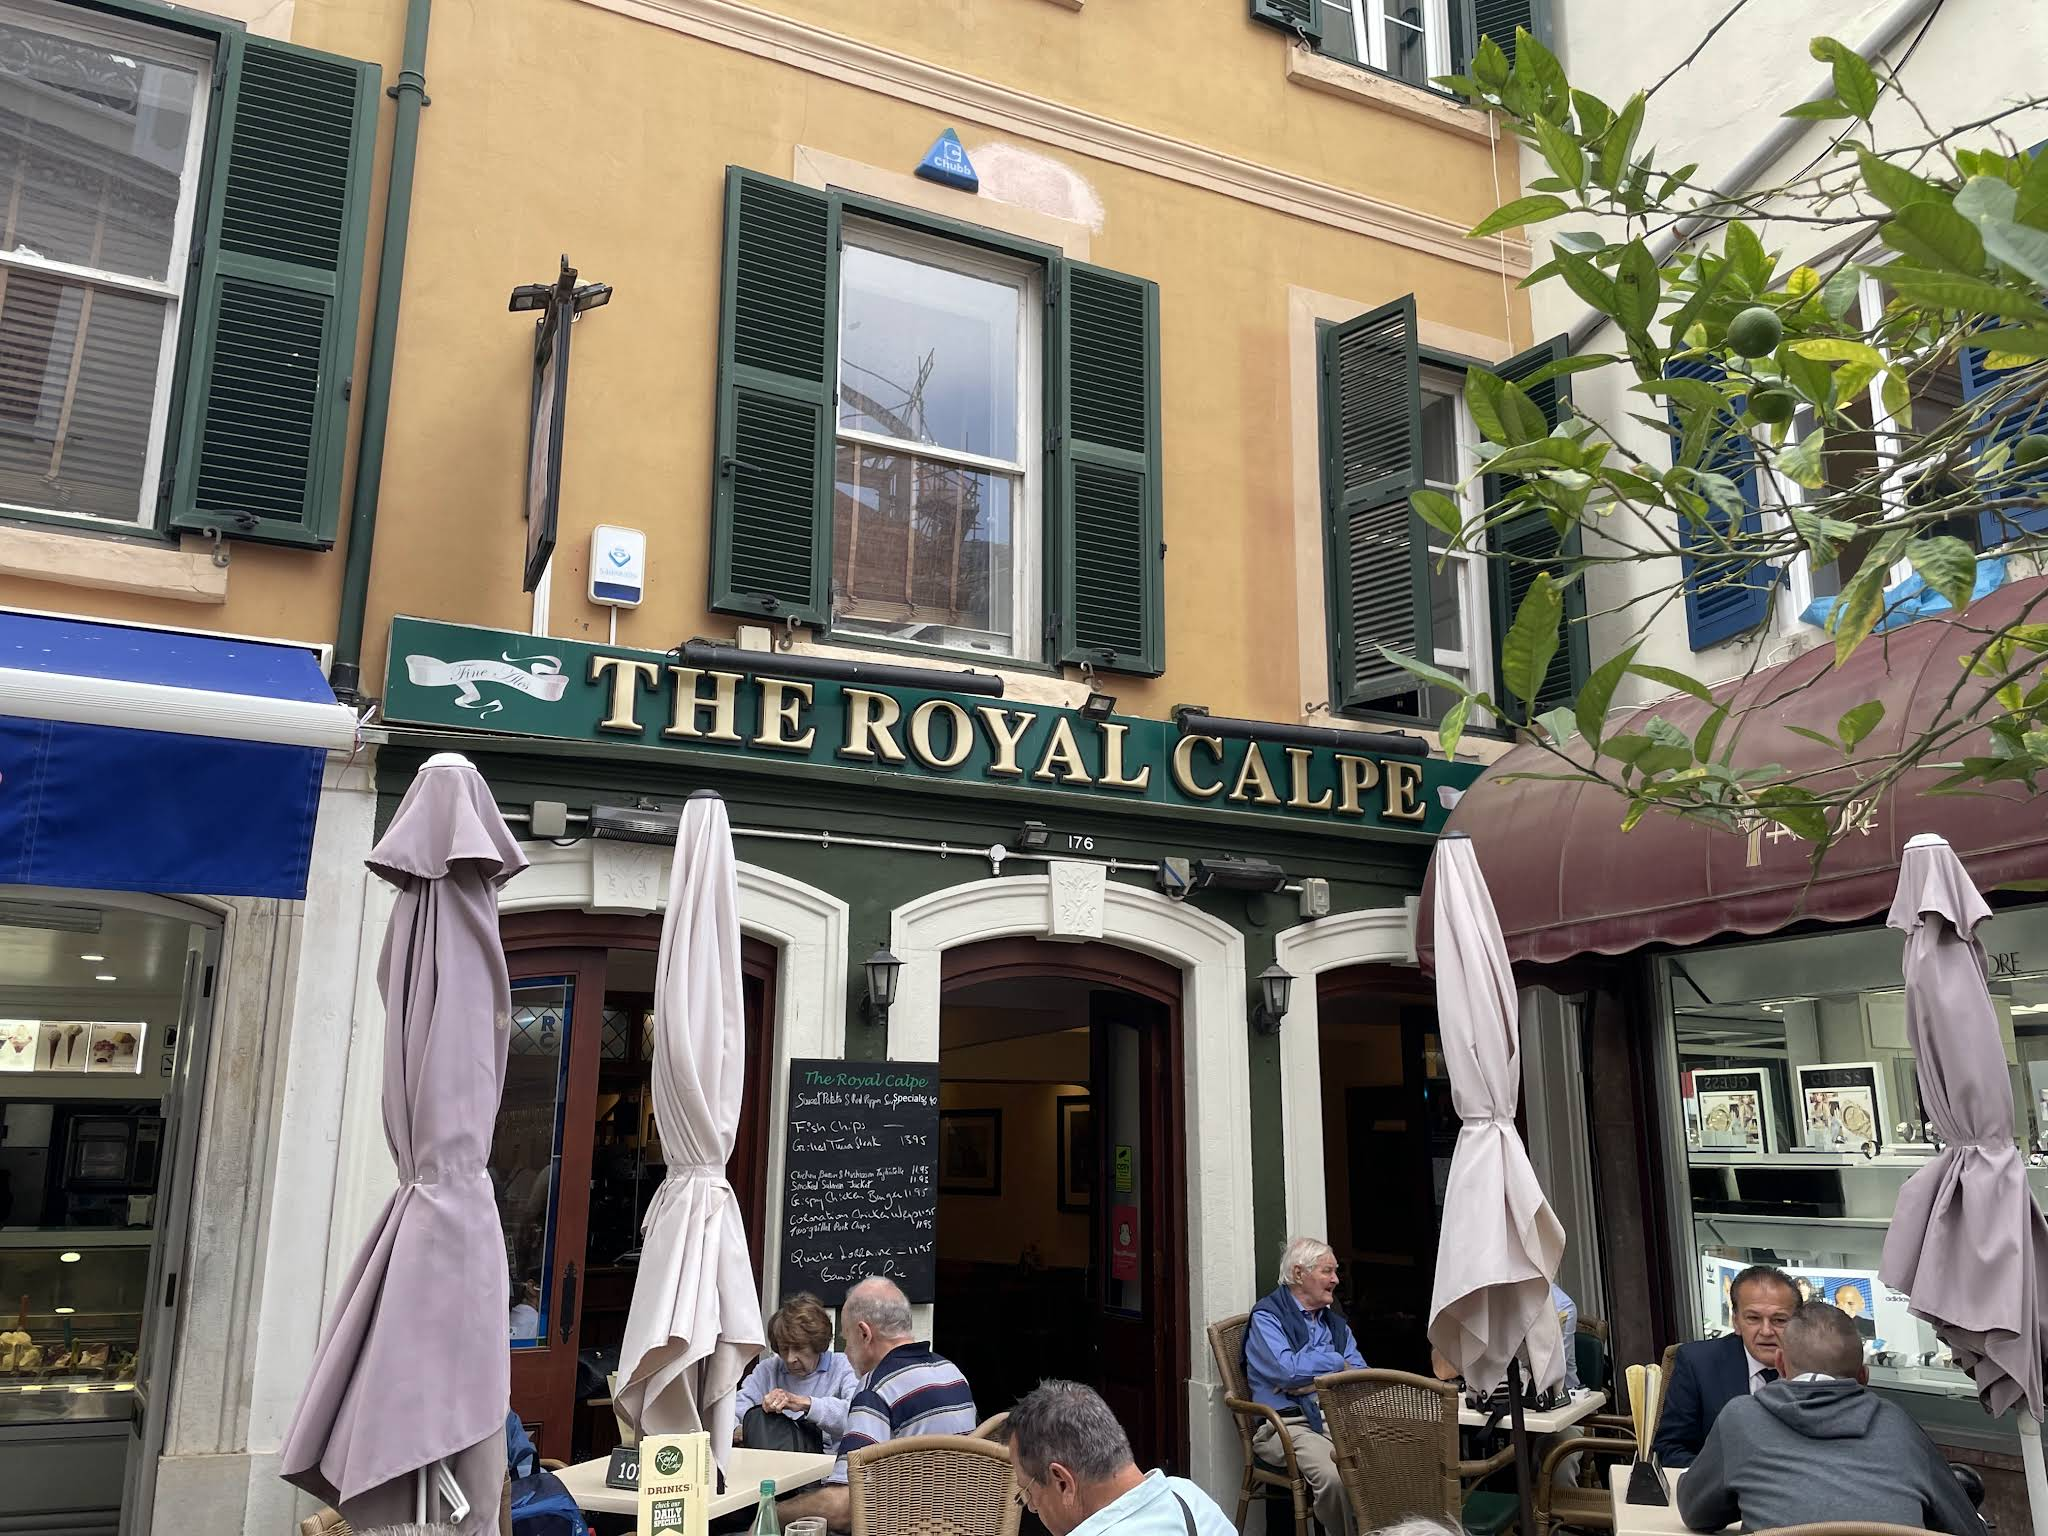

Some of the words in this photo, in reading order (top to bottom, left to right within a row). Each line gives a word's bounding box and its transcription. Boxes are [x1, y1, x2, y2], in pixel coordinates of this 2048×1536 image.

[934, 156, 971, 175] Chubb
[450, 665, 488, 681] Fine
[494, 668, 529, 690] Ales
[590, 655, 816, 751] THE
[840, 687, 1150, 790] ROYAL
[1172, 733, 1427, 821] CALPE
[1068, 834, 1094, 850] 176
[805, 1071, 833, 1085] The
[837, 1073, 881, 1090] Royal
[885, 1074, 928, 1091] Calpe
[791, 1121, 826, 1134] Fish
[830, 1121, 866, 1134] Chips
[825, 1190, 864, 1203] Chicken
[647, 1484, 690, 1496] DRINKS
[653, 1507, 682, 1520] DAILY
[653, 1517, 682, 1528] SPECIALS
